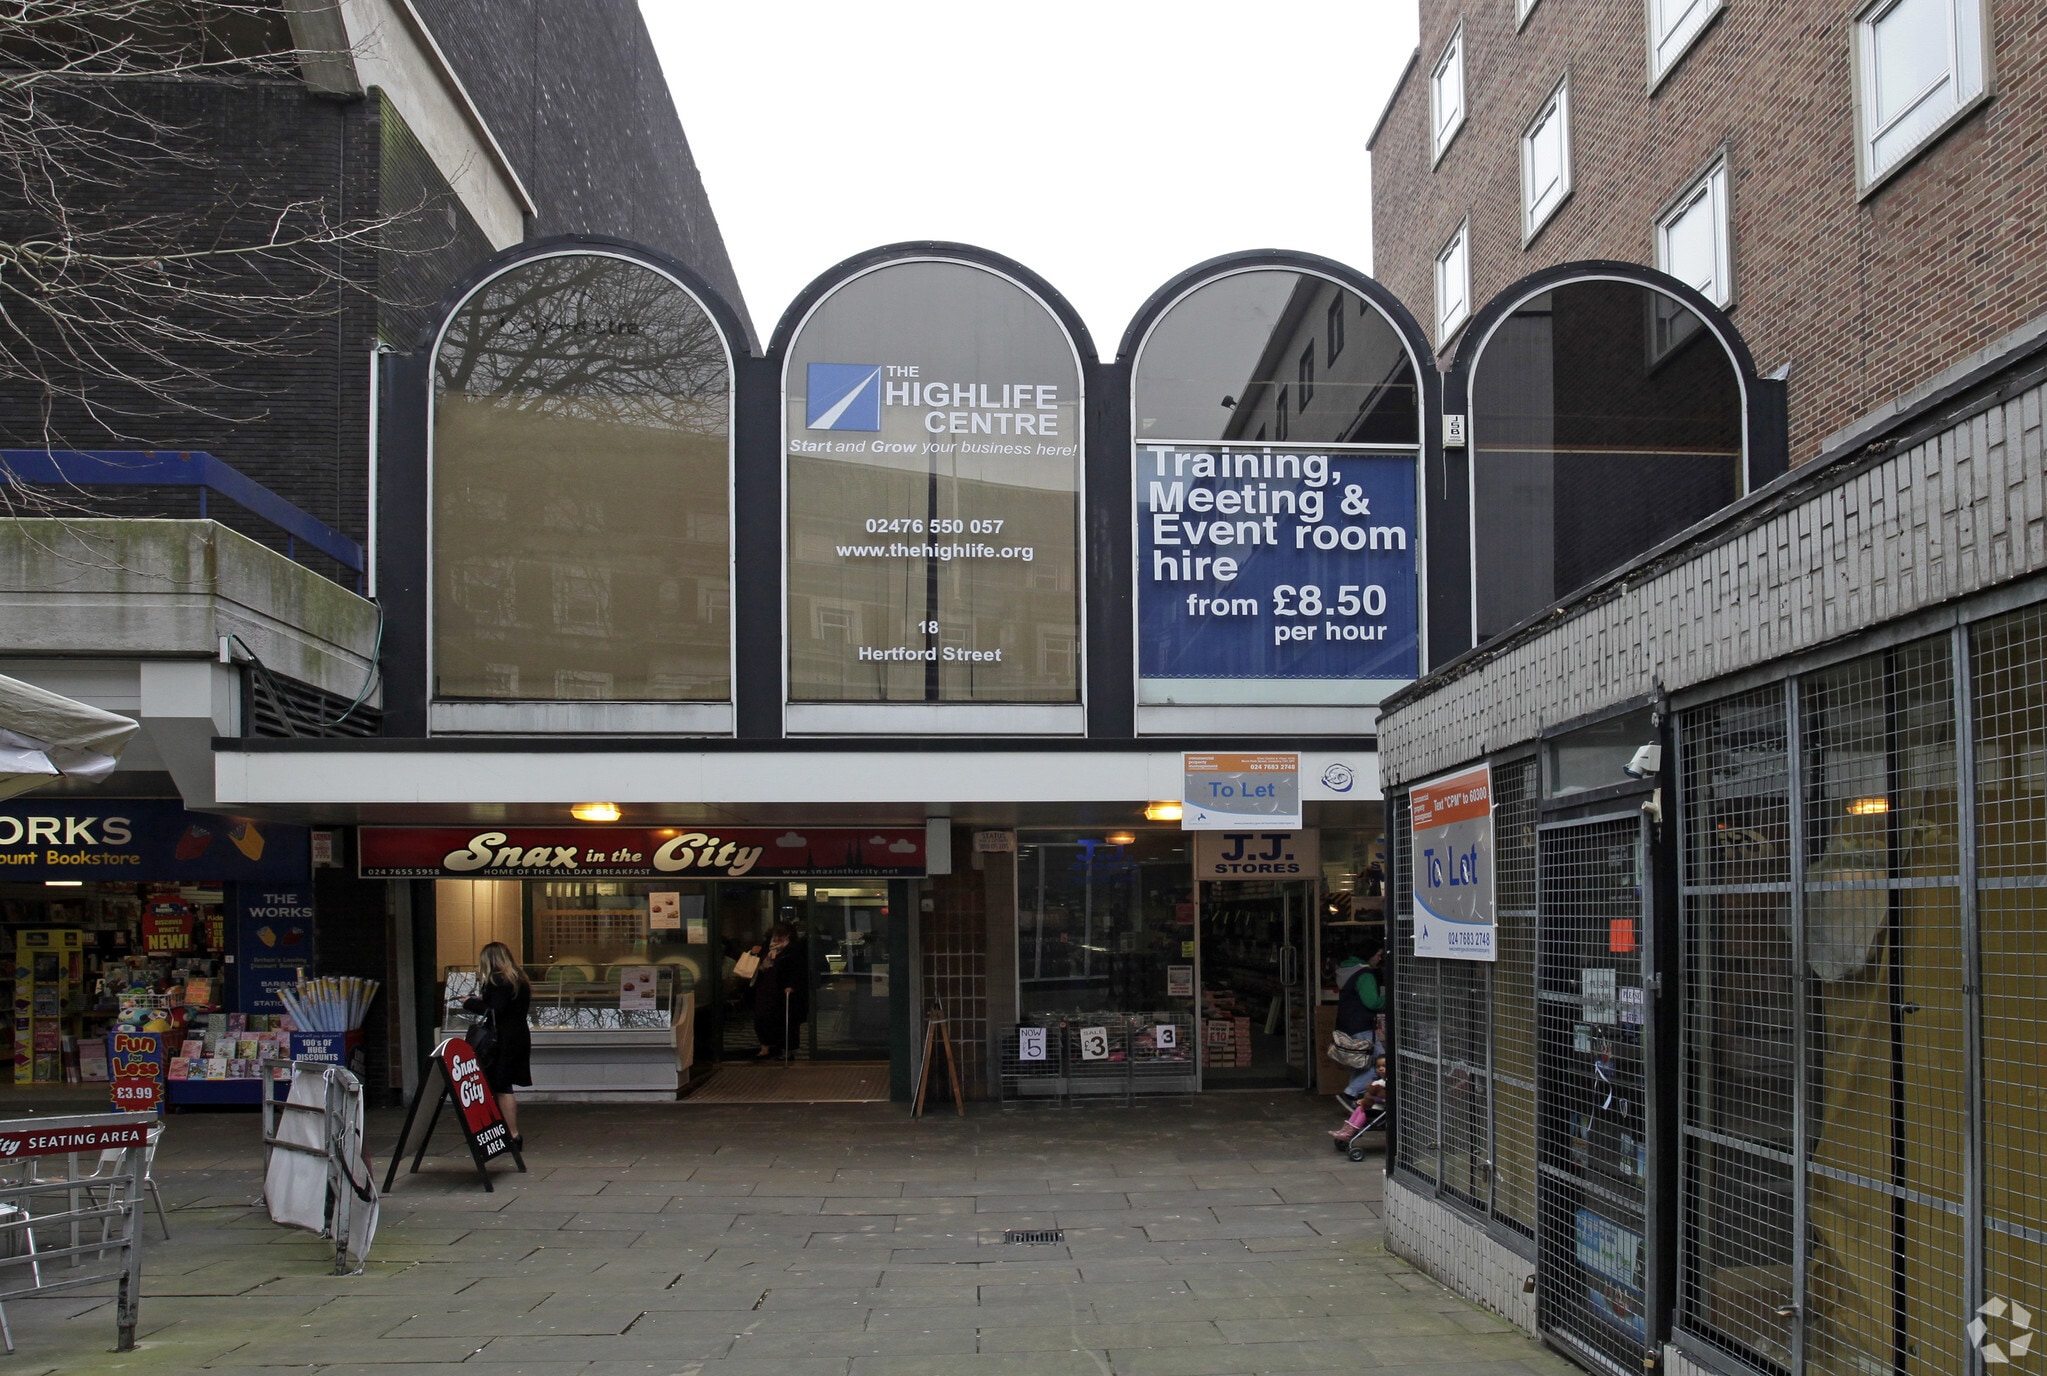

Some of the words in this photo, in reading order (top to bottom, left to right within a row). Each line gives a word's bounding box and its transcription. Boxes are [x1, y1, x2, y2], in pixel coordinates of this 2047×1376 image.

[886, 366, 920, 378] THE
[886, 382, 1058, 410] HIGHLIFE
[924, 411, 1058, 436] CENTRE
[789, 440, 832, 452] Start
[835, 440, 866, 453] and
[871, 440, 917, 453] Grow
[921, 442, 958, 456] your
[961, 441, 1032, 456] business
[1036, 443, 1078, 456] here!
[1147, 446, 1341, 488] Training,
[1150, 482, 1324, 524] Meeting
[1340, 484, 1371, 516] &
[866, 518, 924, 534] 02476
[930, 519, 964, 534] 550
[970, 520, 1004, 534] 057
[1152, 514, 1278, 546] Event
[1295, 525, 1407, 550] room
[836, 542, 1034, 562] www.thehighlife.org
[1153, 550, 1238, 582] hire
[1186, 593, 1258, 616] from
[1272, 584, 1387, 616] £8.50
[918, 620, 939, 634] 18
[1274, 622, 1317, 646] per
[1325, 622, 1388, 640] hour
[858, 646, 936, 662] Hertford
[942, 646, 1002, 662] Street
[1208, 782, 1234, 798] To
[1242, 782, 1275, 798] Let
[1434, 799, 1444, 811] Text
[1462, 792, 1468, 804] to
[1470, 786, 1487, 802] 60300
[443, 832, 579, 872] Snax
[585, 848, 606, 864] in
[611, 848, 642, 864] the
[652, 832, 764, 877] City
[1221, 834, 1294, 861] J.J.
[46, 850, 141, 865] Bookstore
[1424, 848, 1442, 888] To
[1449, 843, 1478, 886] Let
[1215, 863, 1300, 874] STORES
[263, 894, 297, 904] THE
[249, 907, 312, 917] WORKS
[148, 934, 189, 950] NEW!
[1448, 932, 1458, 945] 024
[1459, 932, 1474, 945] 7683
[1475, 932, 1490, 946] 2748
[1021, 1028, 1042, 1037] NOW
[1210, 1032, 1226, 1041] £10
[115, 1034, 156, 1053] Fun
[1084, 1035, 1106, 1056] £3
[113, 1057, 159, 1076] Less
[129, 1053, 143, 1062] for
[452, 1055, 480, 1082] Snax
[117, 1087, 152, 1098] £3.99
[460, 1081, 485, 1108] City
[29, 1133, 96, 1149] SEATING
[100, 1130, 139, 1143] AREA
[476, 1124, 506, 1146] SEATING
[486, 1138, 506, 1156] AREA
